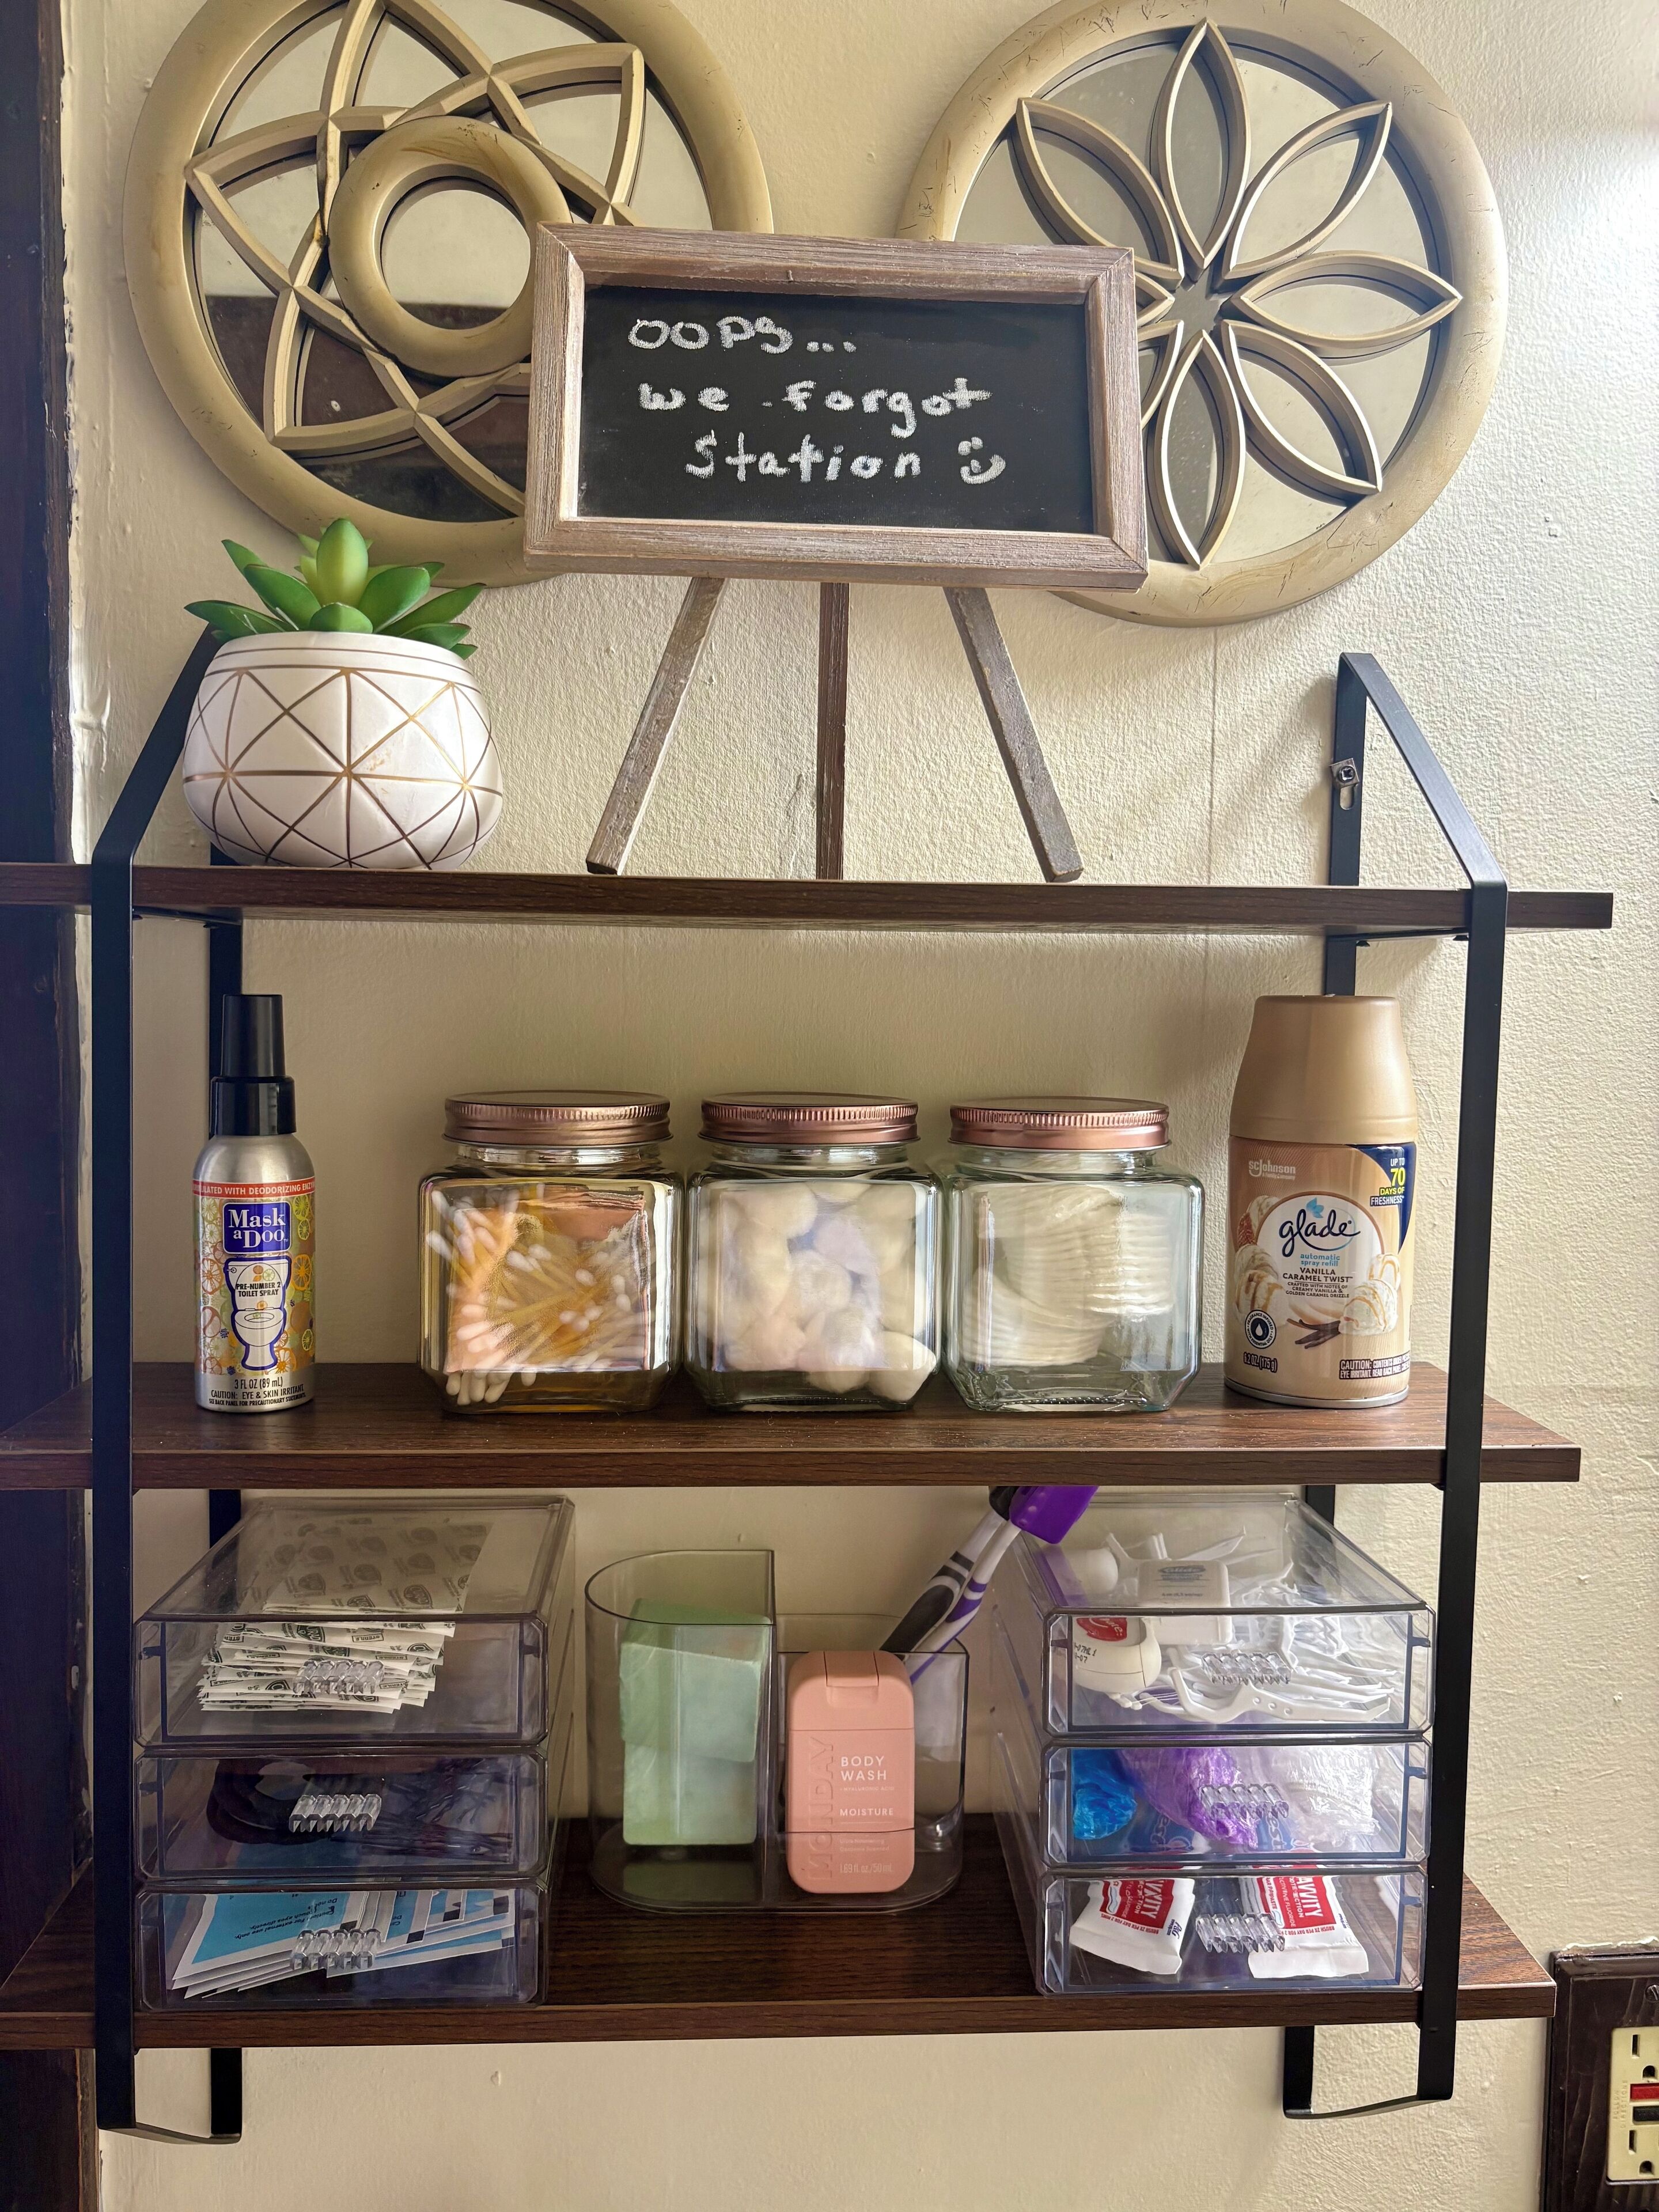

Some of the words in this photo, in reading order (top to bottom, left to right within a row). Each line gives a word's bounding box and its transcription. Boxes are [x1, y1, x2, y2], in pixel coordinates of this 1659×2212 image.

[638, 382, 729, 411] we
[783, 378, 992, 438] forgot
[1390, 1158, 1398, 1166] UP
[1399, 1157, 1405, 1166] TO
[1390, 1167, 1406, 1187] 70
[225, 1187, 246, 1195] WITH
[248, 1184, 301, 1195] DEODORIZING
[1380, 1187, 1397, 1195] DAYS
[228, 1207, 286, 1228] Mask
[233, 1229, 243, 1240] a
[1278, 1209, 1361, 1257] glade
[1300, 1267, 1336, 1275] VANILLA
[1282, 1272, 1322, 1282] CARAMEL
[236, 1282, 275, 1290] PRE-NUMBER
[1340, 1359, 1372, 1370] CAUTION:
[1340, 1370, 1350, 1378] EYE
[234, 1379, 239, 1389] 3
[240, 1379, 247, 1389] FL
[249, 1378, 258, 1389] OZ
[260, 1378, 270, 1389] (89
[272, 1376, 283, 1388] mL)
[211, 1389, 238, 1399] CAUTION:
[242, 1391, 254, 1399] EYE
[263, 1388, 279, 1399] SKIN
[281, 1384, 305, 1396] IRRITANT
[249, 1397, 285, 1406] PRECAUTIONARY
[841, 1755, 884, 1767] BODY
[841, 1770, 887, 1781] WASH
[840, 1808, 893, 1816] MOISTURE
